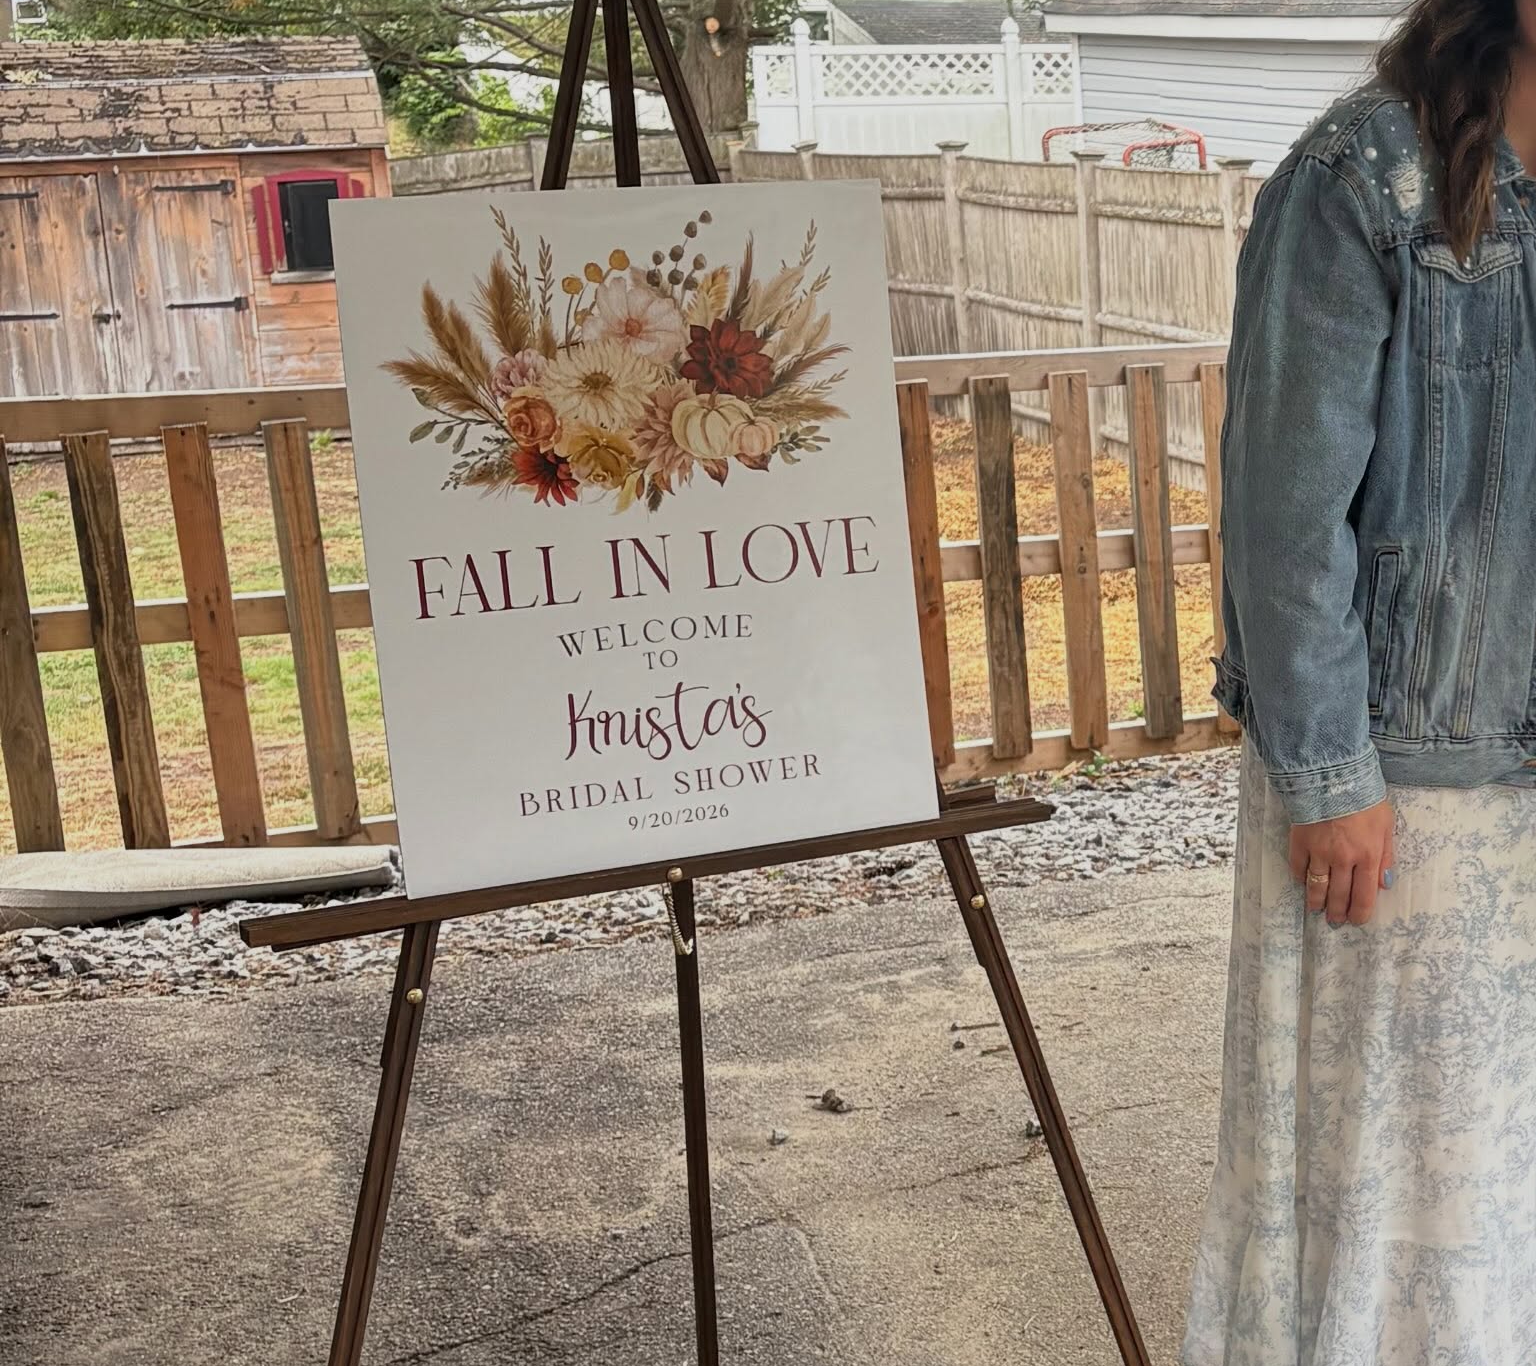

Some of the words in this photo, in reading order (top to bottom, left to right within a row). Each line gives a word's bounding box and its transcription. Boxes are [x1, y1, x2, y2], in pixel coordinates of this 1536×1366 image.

[408, 546, 582, 621] FALL
[604, 534, 671, 600] IN
[698, 515, 880, 590] LOVE
[556, 614, 753, 657] WELCOME
[642, 649, 679, 670] TO
[519, 776, 654, 817] BRIDAL
[673, 753, 822, 795] SHOWER
[628, 803, 729, 831] 9/20/2026
